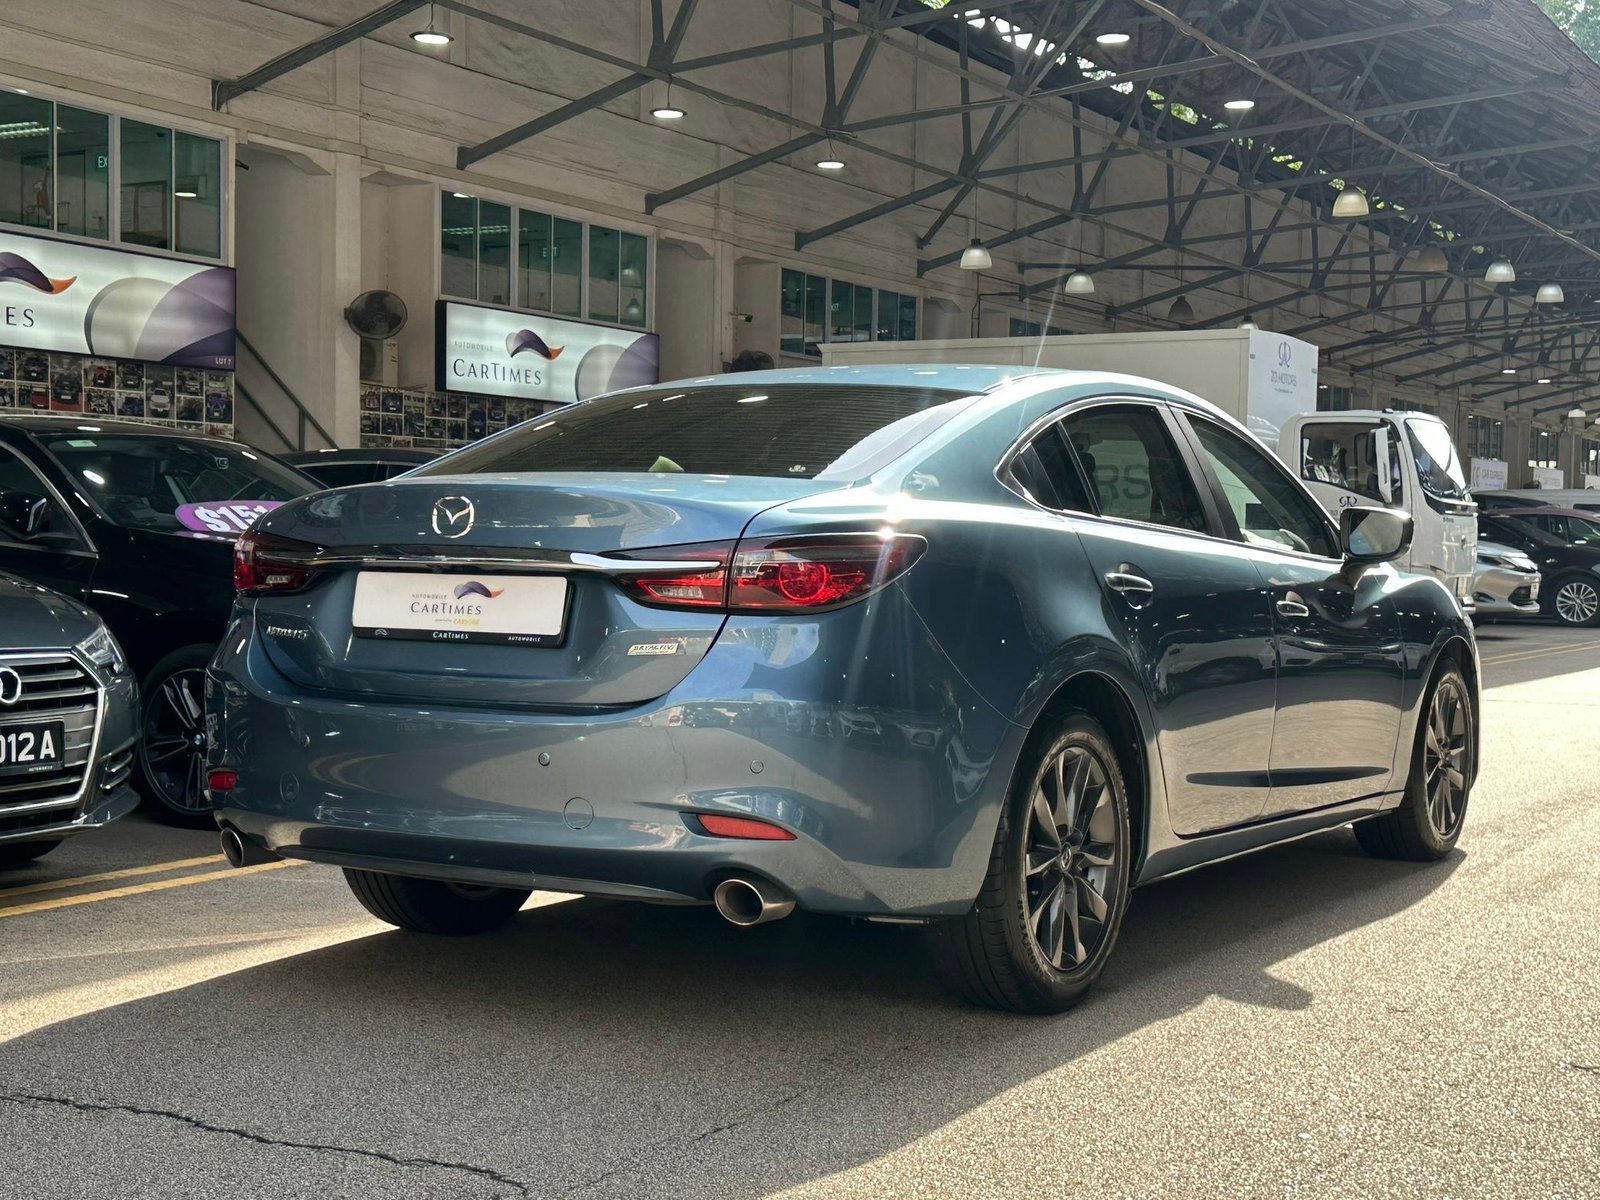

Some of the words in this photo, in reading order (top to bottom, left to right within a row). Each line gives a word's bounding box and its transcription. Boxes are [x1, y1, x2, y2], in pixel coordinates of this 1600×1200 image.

[6, 306, 34, 328] ES
[454, 340, 493, 352] AUTOMOBILE
[215, 357, 226, 365] LOT
[40, 730, 56, 760] A
